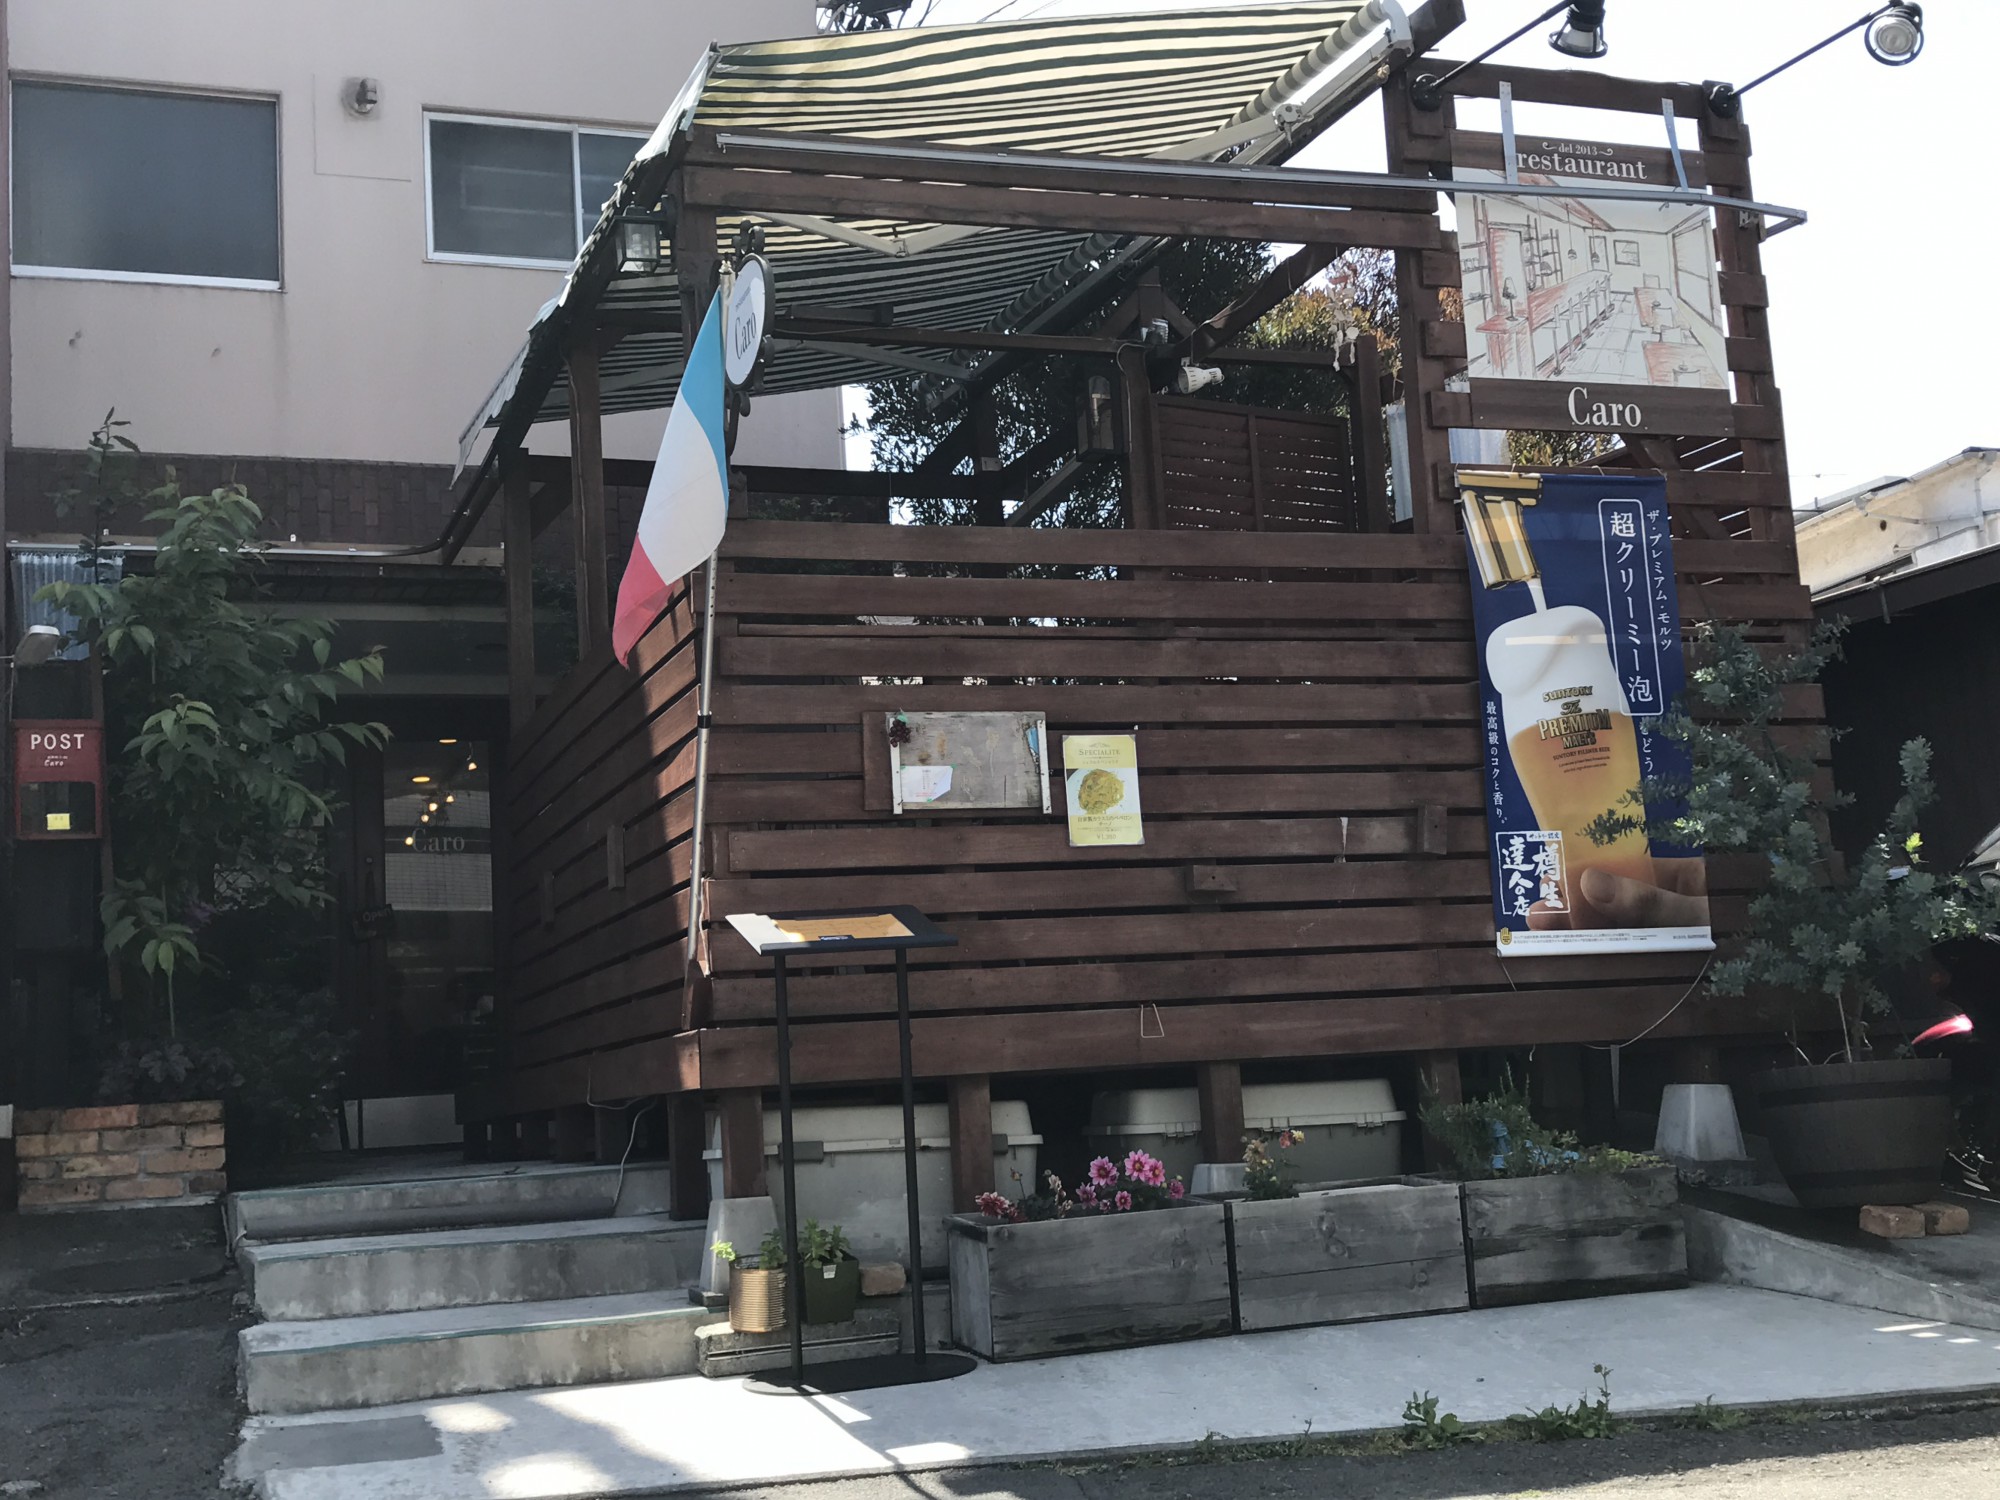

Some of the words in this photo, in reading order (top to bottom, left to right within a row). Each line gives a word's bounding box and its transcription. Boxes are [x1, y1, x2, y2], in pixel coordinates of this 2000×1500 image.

[1516, 151, 1648, 180] restaurant
[1558, 142, 1573, 154] del
[1575, 144, 1598, 156] 2013
[735, 312, 757, 360] Caro
[1567, 386, 1642, 428] Caro
[1647, 509, 1672, 651] ザ・プレミアム・モルツ
[1610, 511, 1653, 703] 超クリーミー泡
[30, 733, 85, 750] POST
[1537, 709, 1613, 741] PREMIUM
[1486, 701, 1508, 824] 最高級のコクと香り。
[411, 827, 465, 853] Caro
[1502, 834, 1535, 917] 達人の店
[1532, 843, 1564, 909] 樽生
